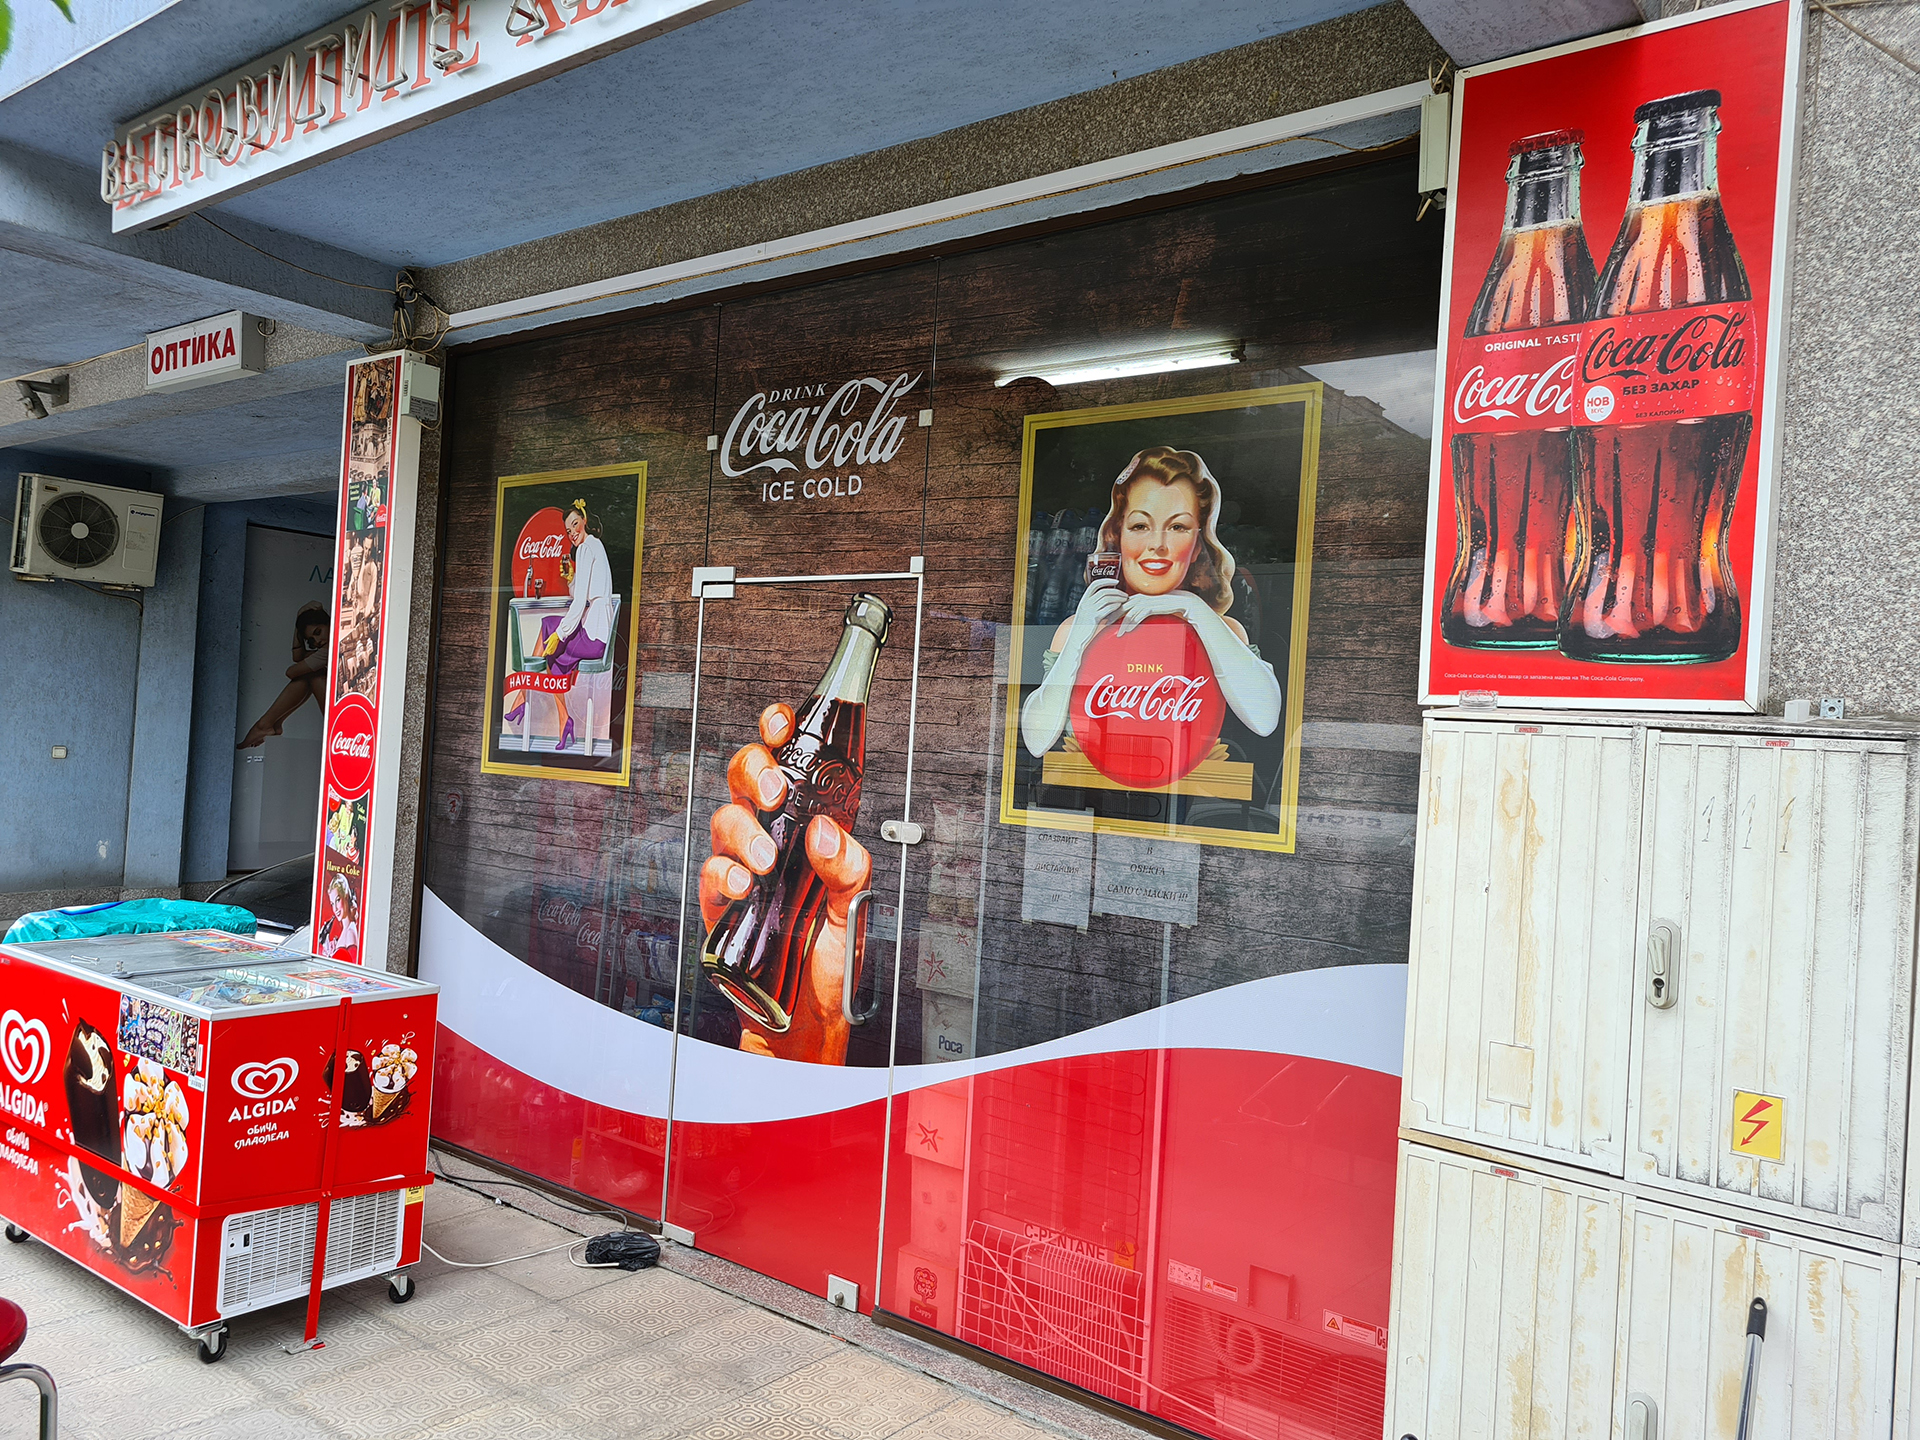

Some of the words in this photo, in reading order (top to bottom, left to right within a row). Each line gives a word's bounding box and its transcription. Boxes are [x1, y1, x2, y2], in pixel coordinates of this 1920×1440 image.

[151, 327, 236, 375] ОПТИКА
[1484, 339, 1541, 352] ORIGINAL
[1582, 312, 1748, 383] Coca-Cola
[768, 382, 828, 404] DRINK
[1622, 384, 1647, 396] БЕЗ
[1650, 379, 1700, 393] ЗАХАР
[1587, 396, 1610, 407] НОВ
[720, 370, 924, 478] Coca-Cola
[762, 480, 795, 502] ICE
[803, 475, 863, 499] COLD
[519, 534, 565, 560] Coca-Cola
[1127, 663, 1164, 673] DRINK
[509, 674, 531, 689] HAVE
[534, 675, 540, 687] A
[542, 677, 568, 690] COKE
[1084, 673, 1210, 723] Coca-Cola
[331, 731, 373, 758] Coca-Cola
[326, 860, 341, 873] Have
[345, 863, 361, 876] Coke
[1034, 862, 1080, 875] ДИСТАНЦИЯ
[1107, 884, 1134, 895] САМО
[1142, 889, 1177, 901] МАСКИ
[938, 1034, 963, 1054] Роса
[228, 1097, 297, 1123] ALGIDA
[1024, 1223, 1108, 1260] C-PENTANE
